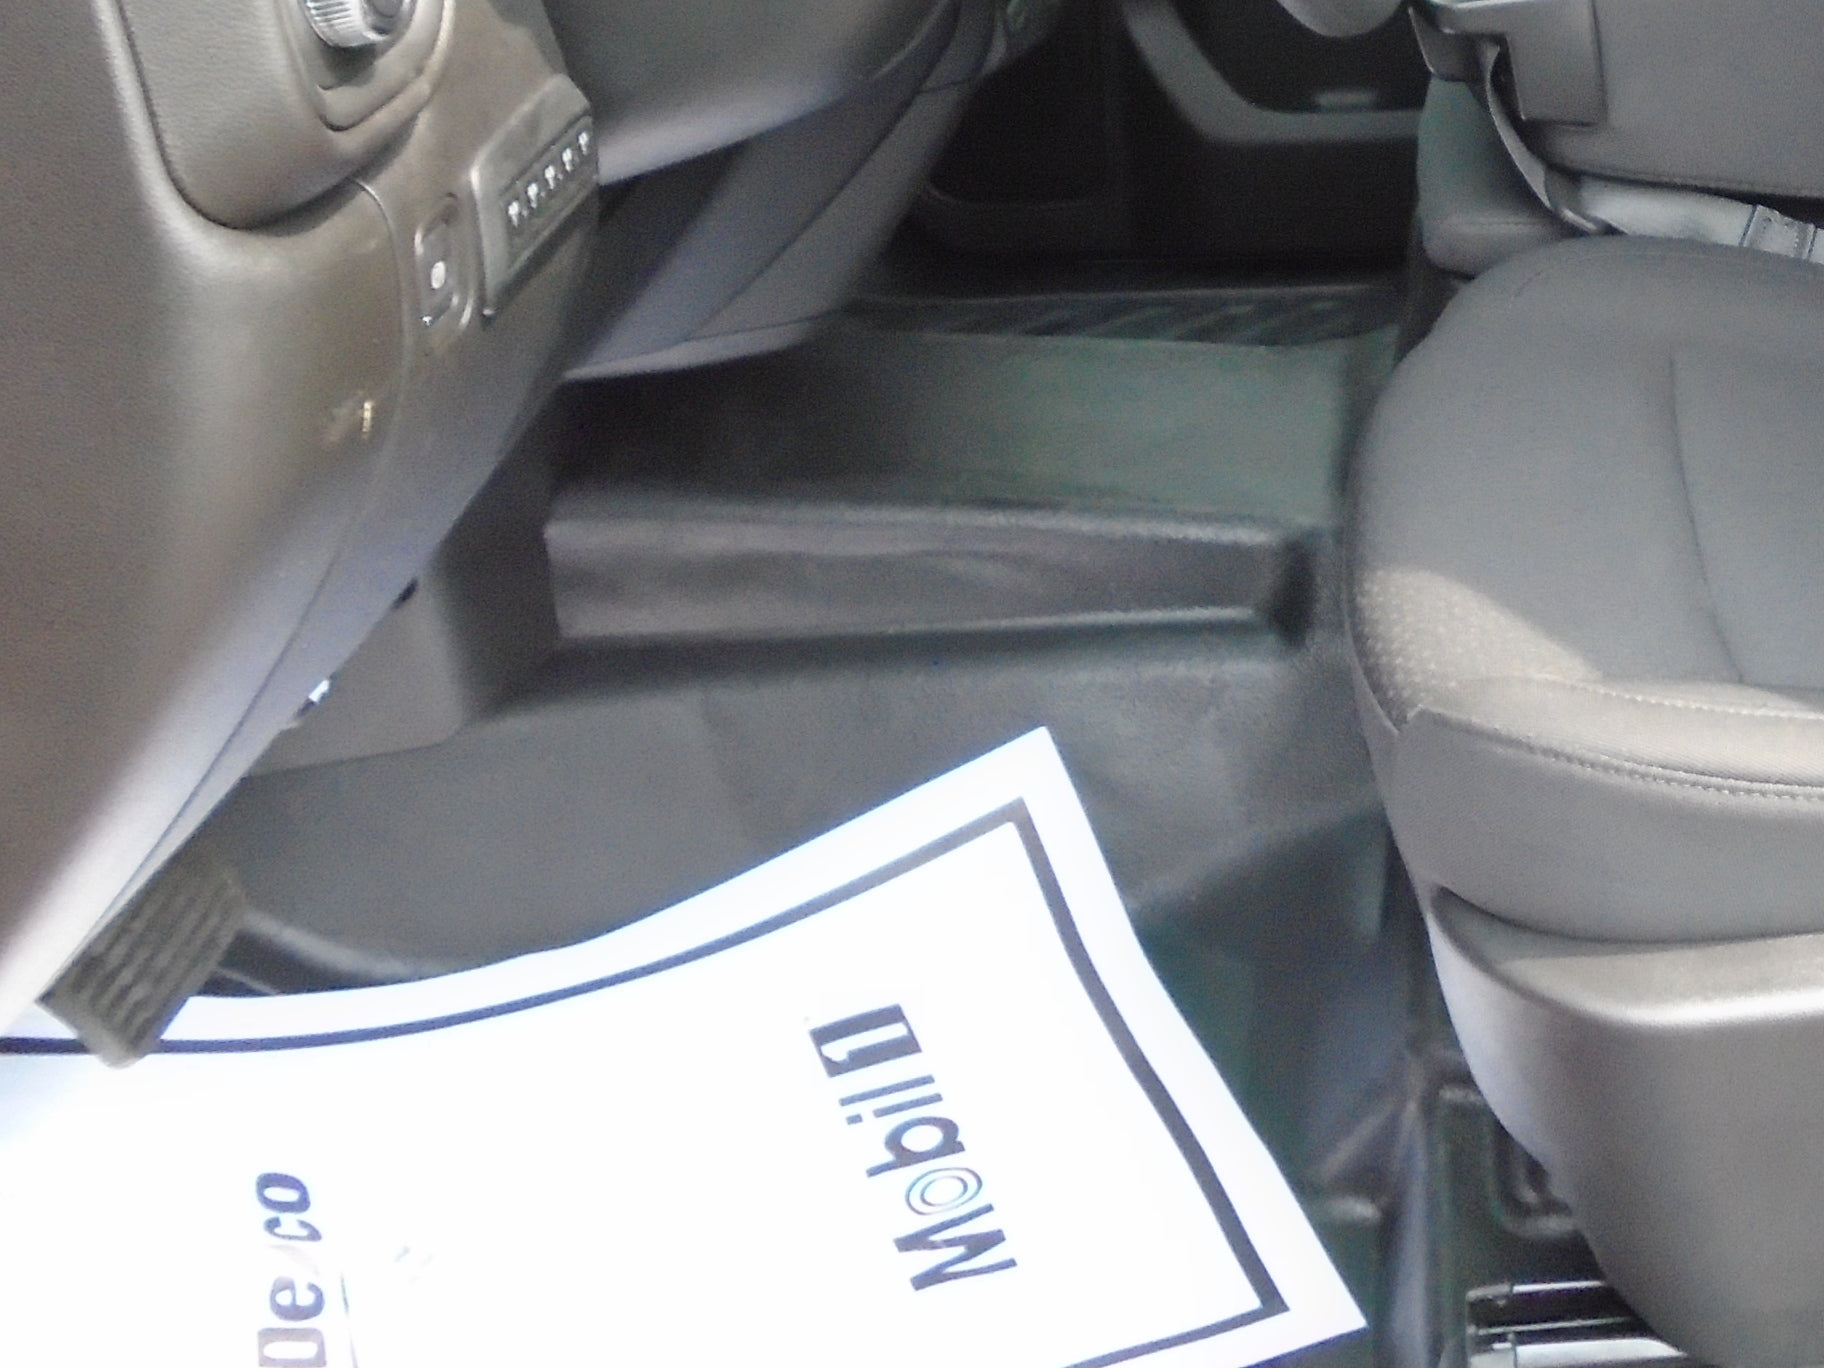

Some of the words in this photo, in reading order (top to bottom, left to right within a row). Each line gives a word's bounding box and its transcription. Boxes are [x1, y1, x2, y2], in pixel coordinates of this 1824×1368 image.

[814, 1014, 916, 1069] 1
[254, 1172, 327, 1368] Deco
[837, 1074, 1018, 1292] Mobil
